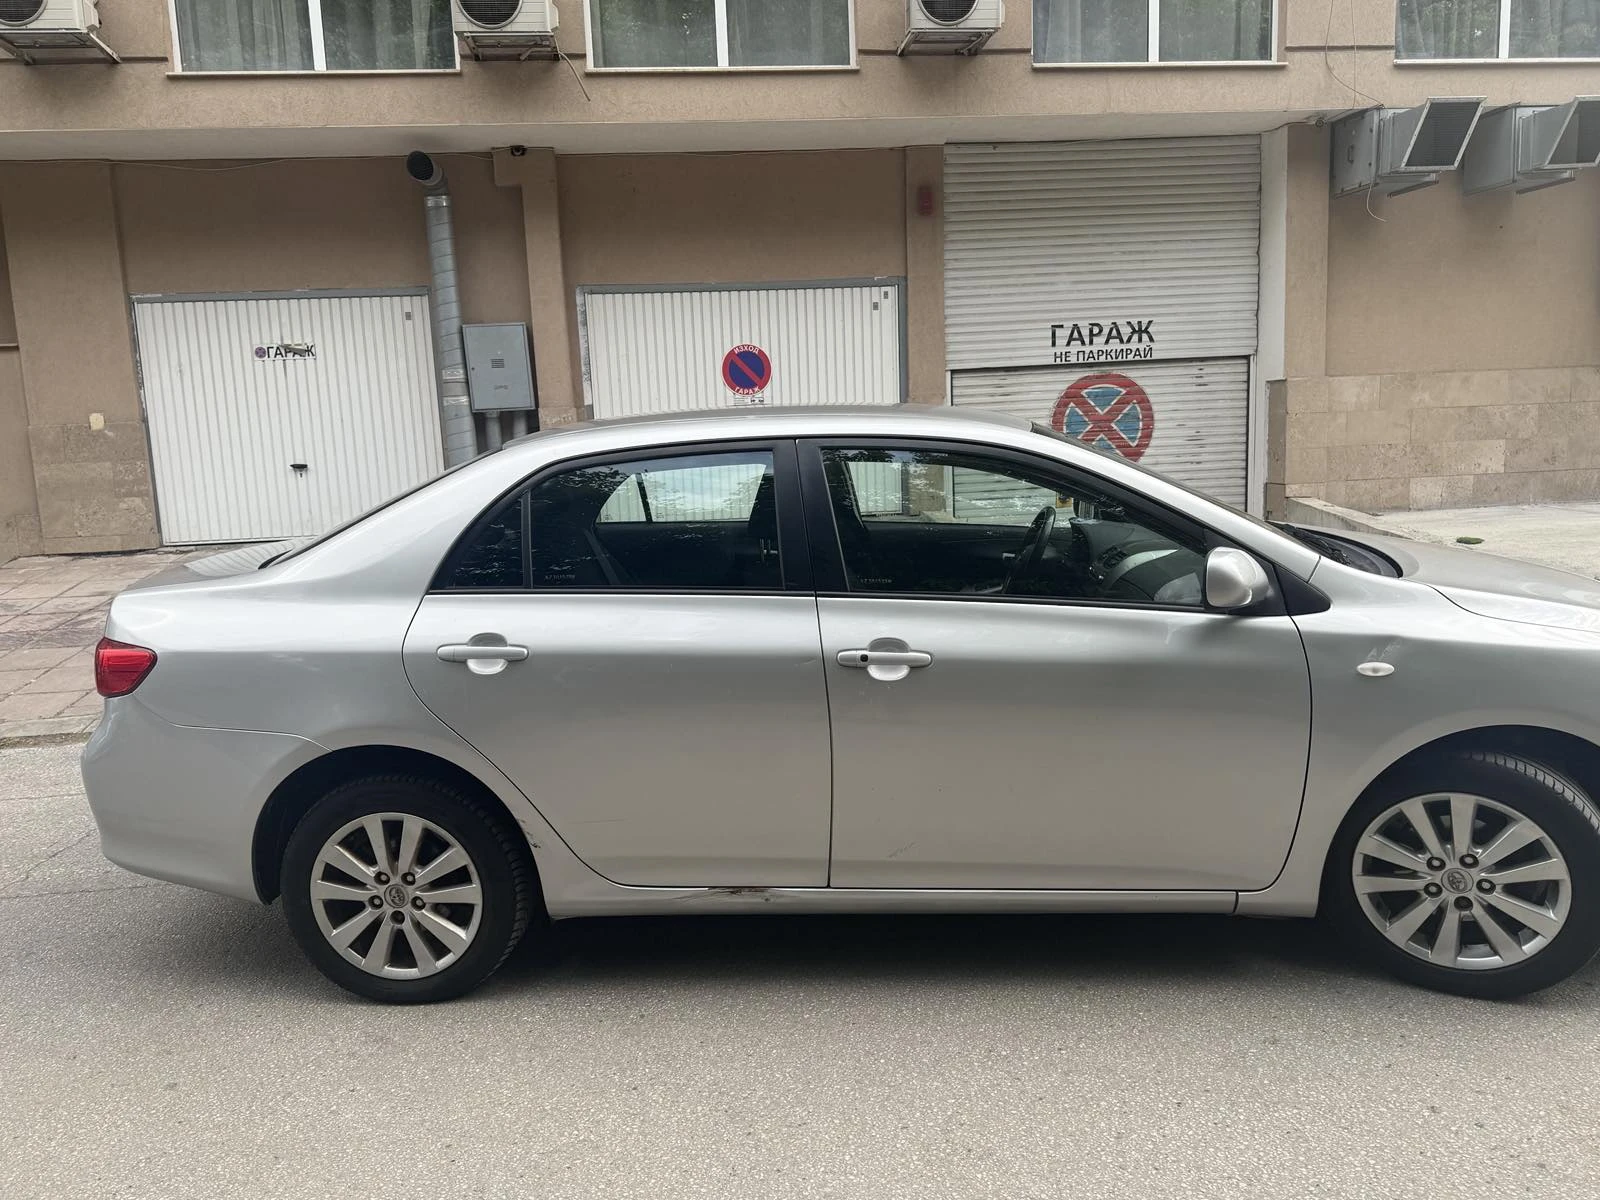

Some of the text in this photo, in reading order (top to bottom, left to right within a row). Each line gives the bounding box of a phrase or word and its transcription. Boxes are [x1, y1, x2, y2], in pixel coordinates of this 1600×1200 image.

[1050, 320, 1155, 347] ГАРАЖ
[733, 345, 760, 354] ИЗХОД
[1054, 345, 1153, 363] НЕ ПАРКИРАЙ
